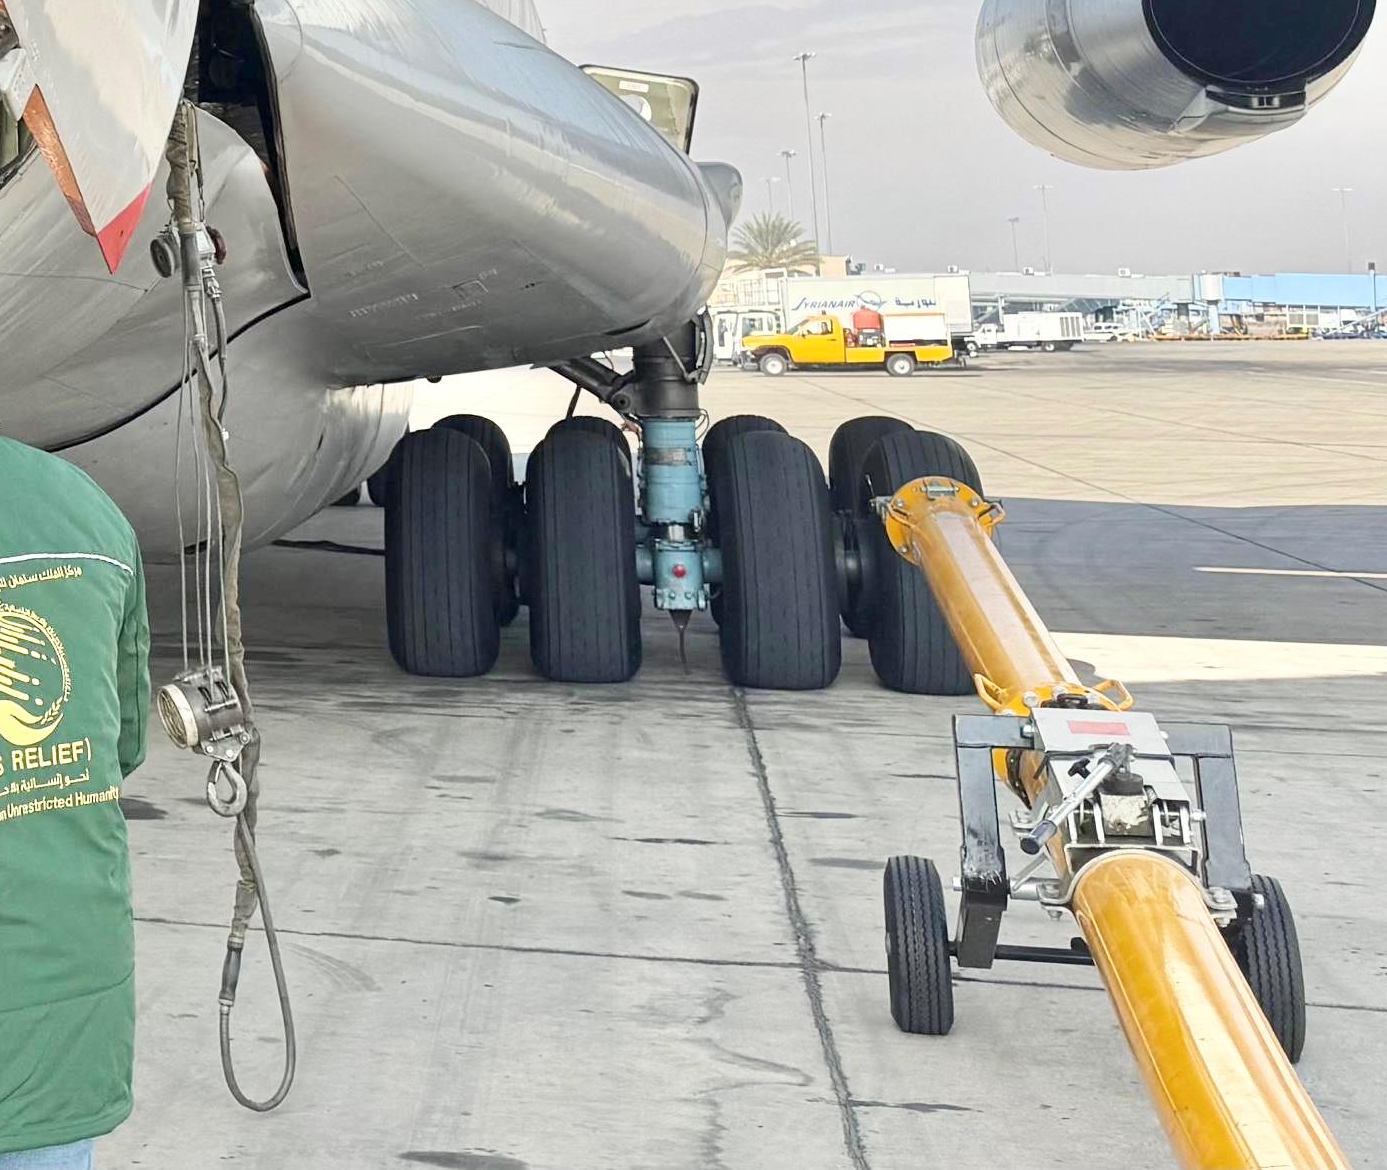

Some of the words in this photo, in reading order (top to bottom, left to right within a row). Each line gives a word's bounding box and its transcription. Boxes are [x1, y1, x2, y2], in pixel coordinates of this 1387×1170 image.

[791, 296, 856, 311] SYRIANAIR
[11, 736, 93, 772] RELIEF)
[7, 794, 74, 820] Unrestricted
[75, 784, 121, 807] Humanity
